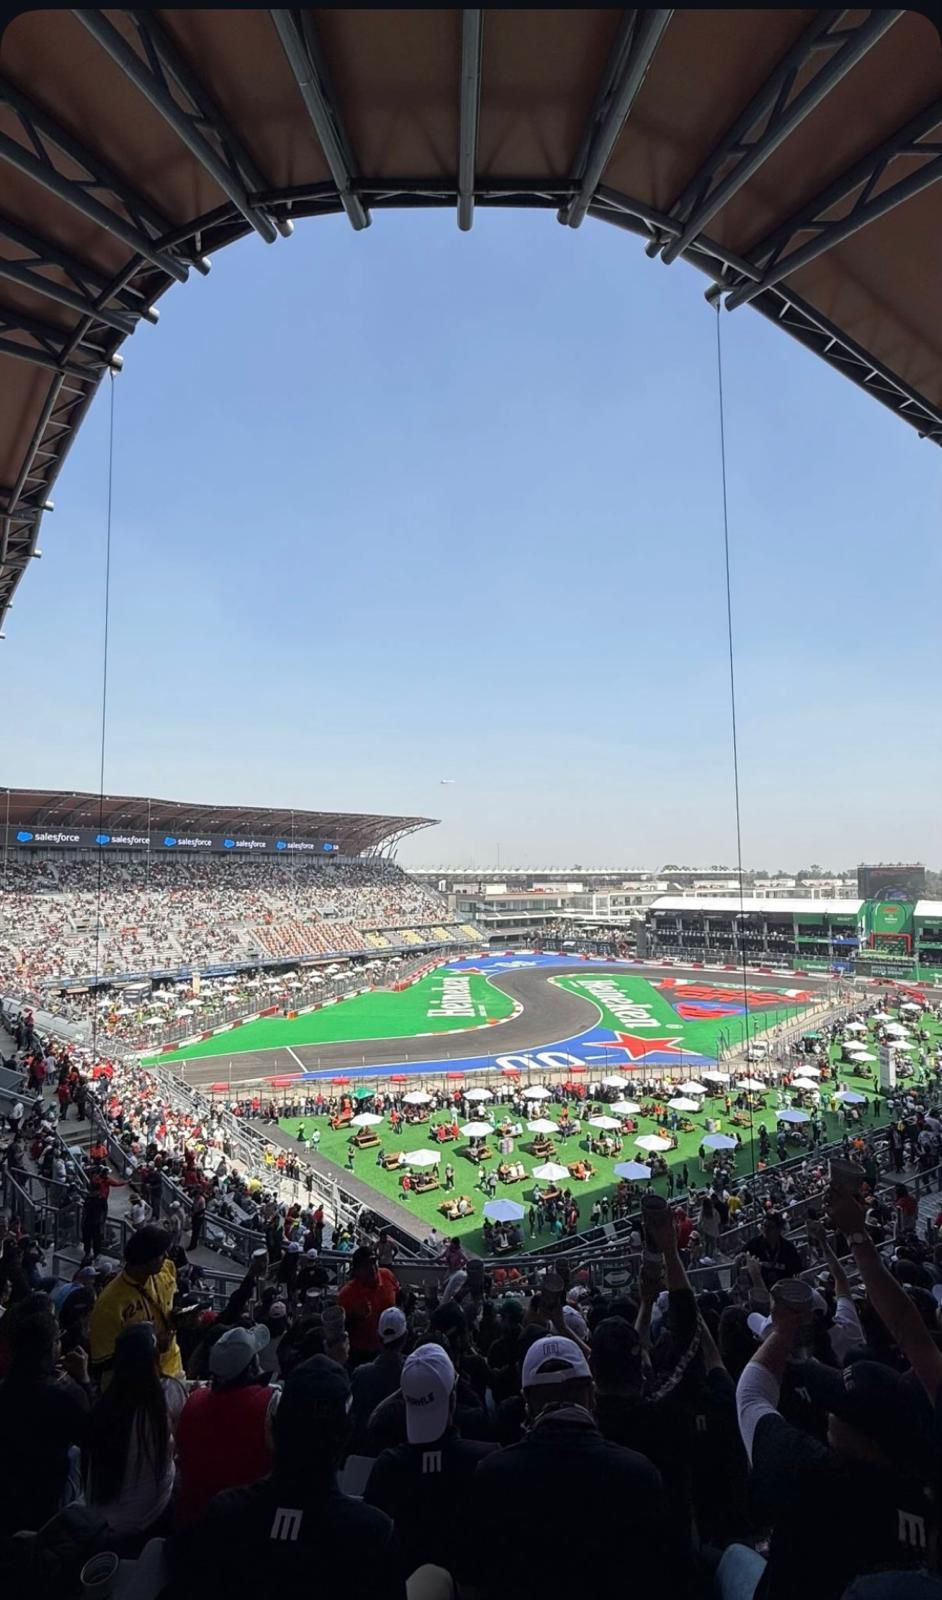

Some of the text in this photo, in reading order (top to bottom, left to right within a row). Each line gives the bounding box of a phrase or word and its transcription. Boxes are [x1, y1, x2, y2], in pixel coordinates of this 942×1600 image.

[34, 832, 81, 844] salesforce
[111, 835, 151, 847] salesforce
[177, 837, 213, 848] salesforce
[235, 839, 267, 850] salesforce
[287, 841, 315, 851] salesforce
[426, 976, 476, 1017] Heineken
[576, 979, 662, 1029] Heineken
